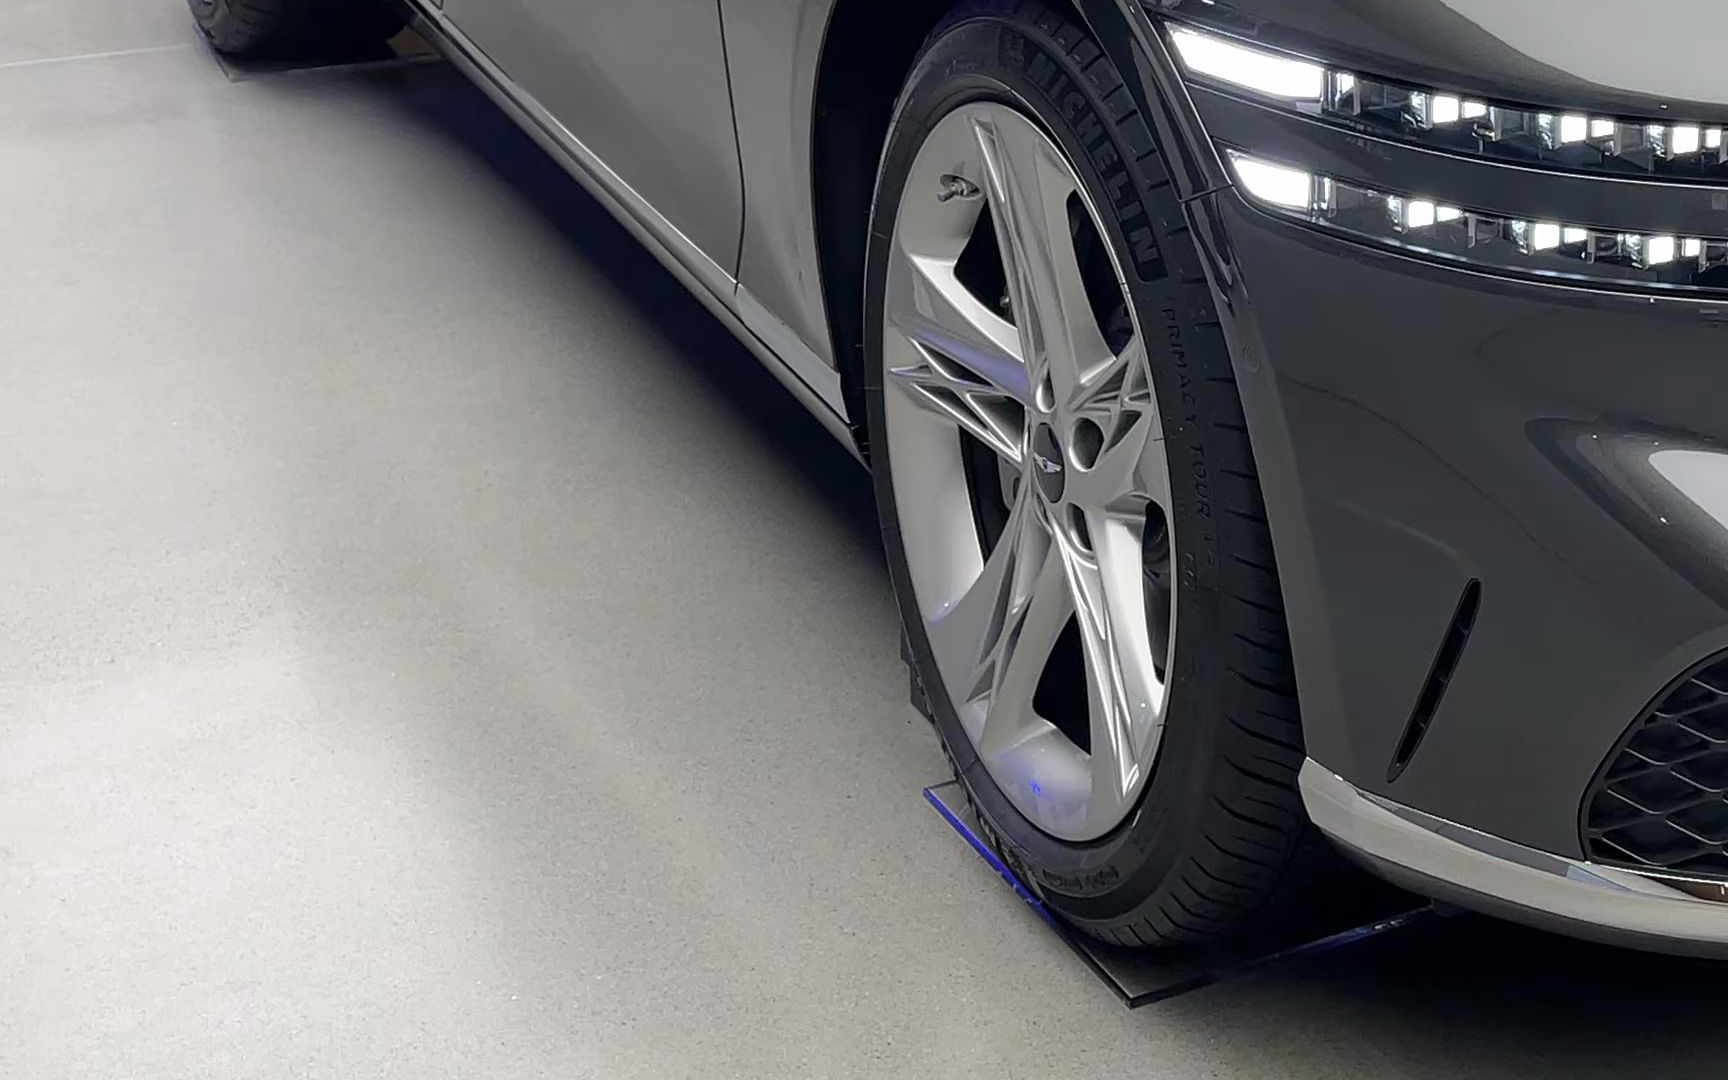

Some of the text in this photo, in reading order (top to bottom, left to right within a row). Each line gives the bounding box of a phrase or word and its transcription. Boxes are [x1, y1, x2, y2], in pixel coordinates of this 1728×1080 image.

[1025, 52, 1160, 264] MICHELIN
[1160, 308, 1199, 431] PRIMACY
[1189, 444, 1212, 520] TOUR
